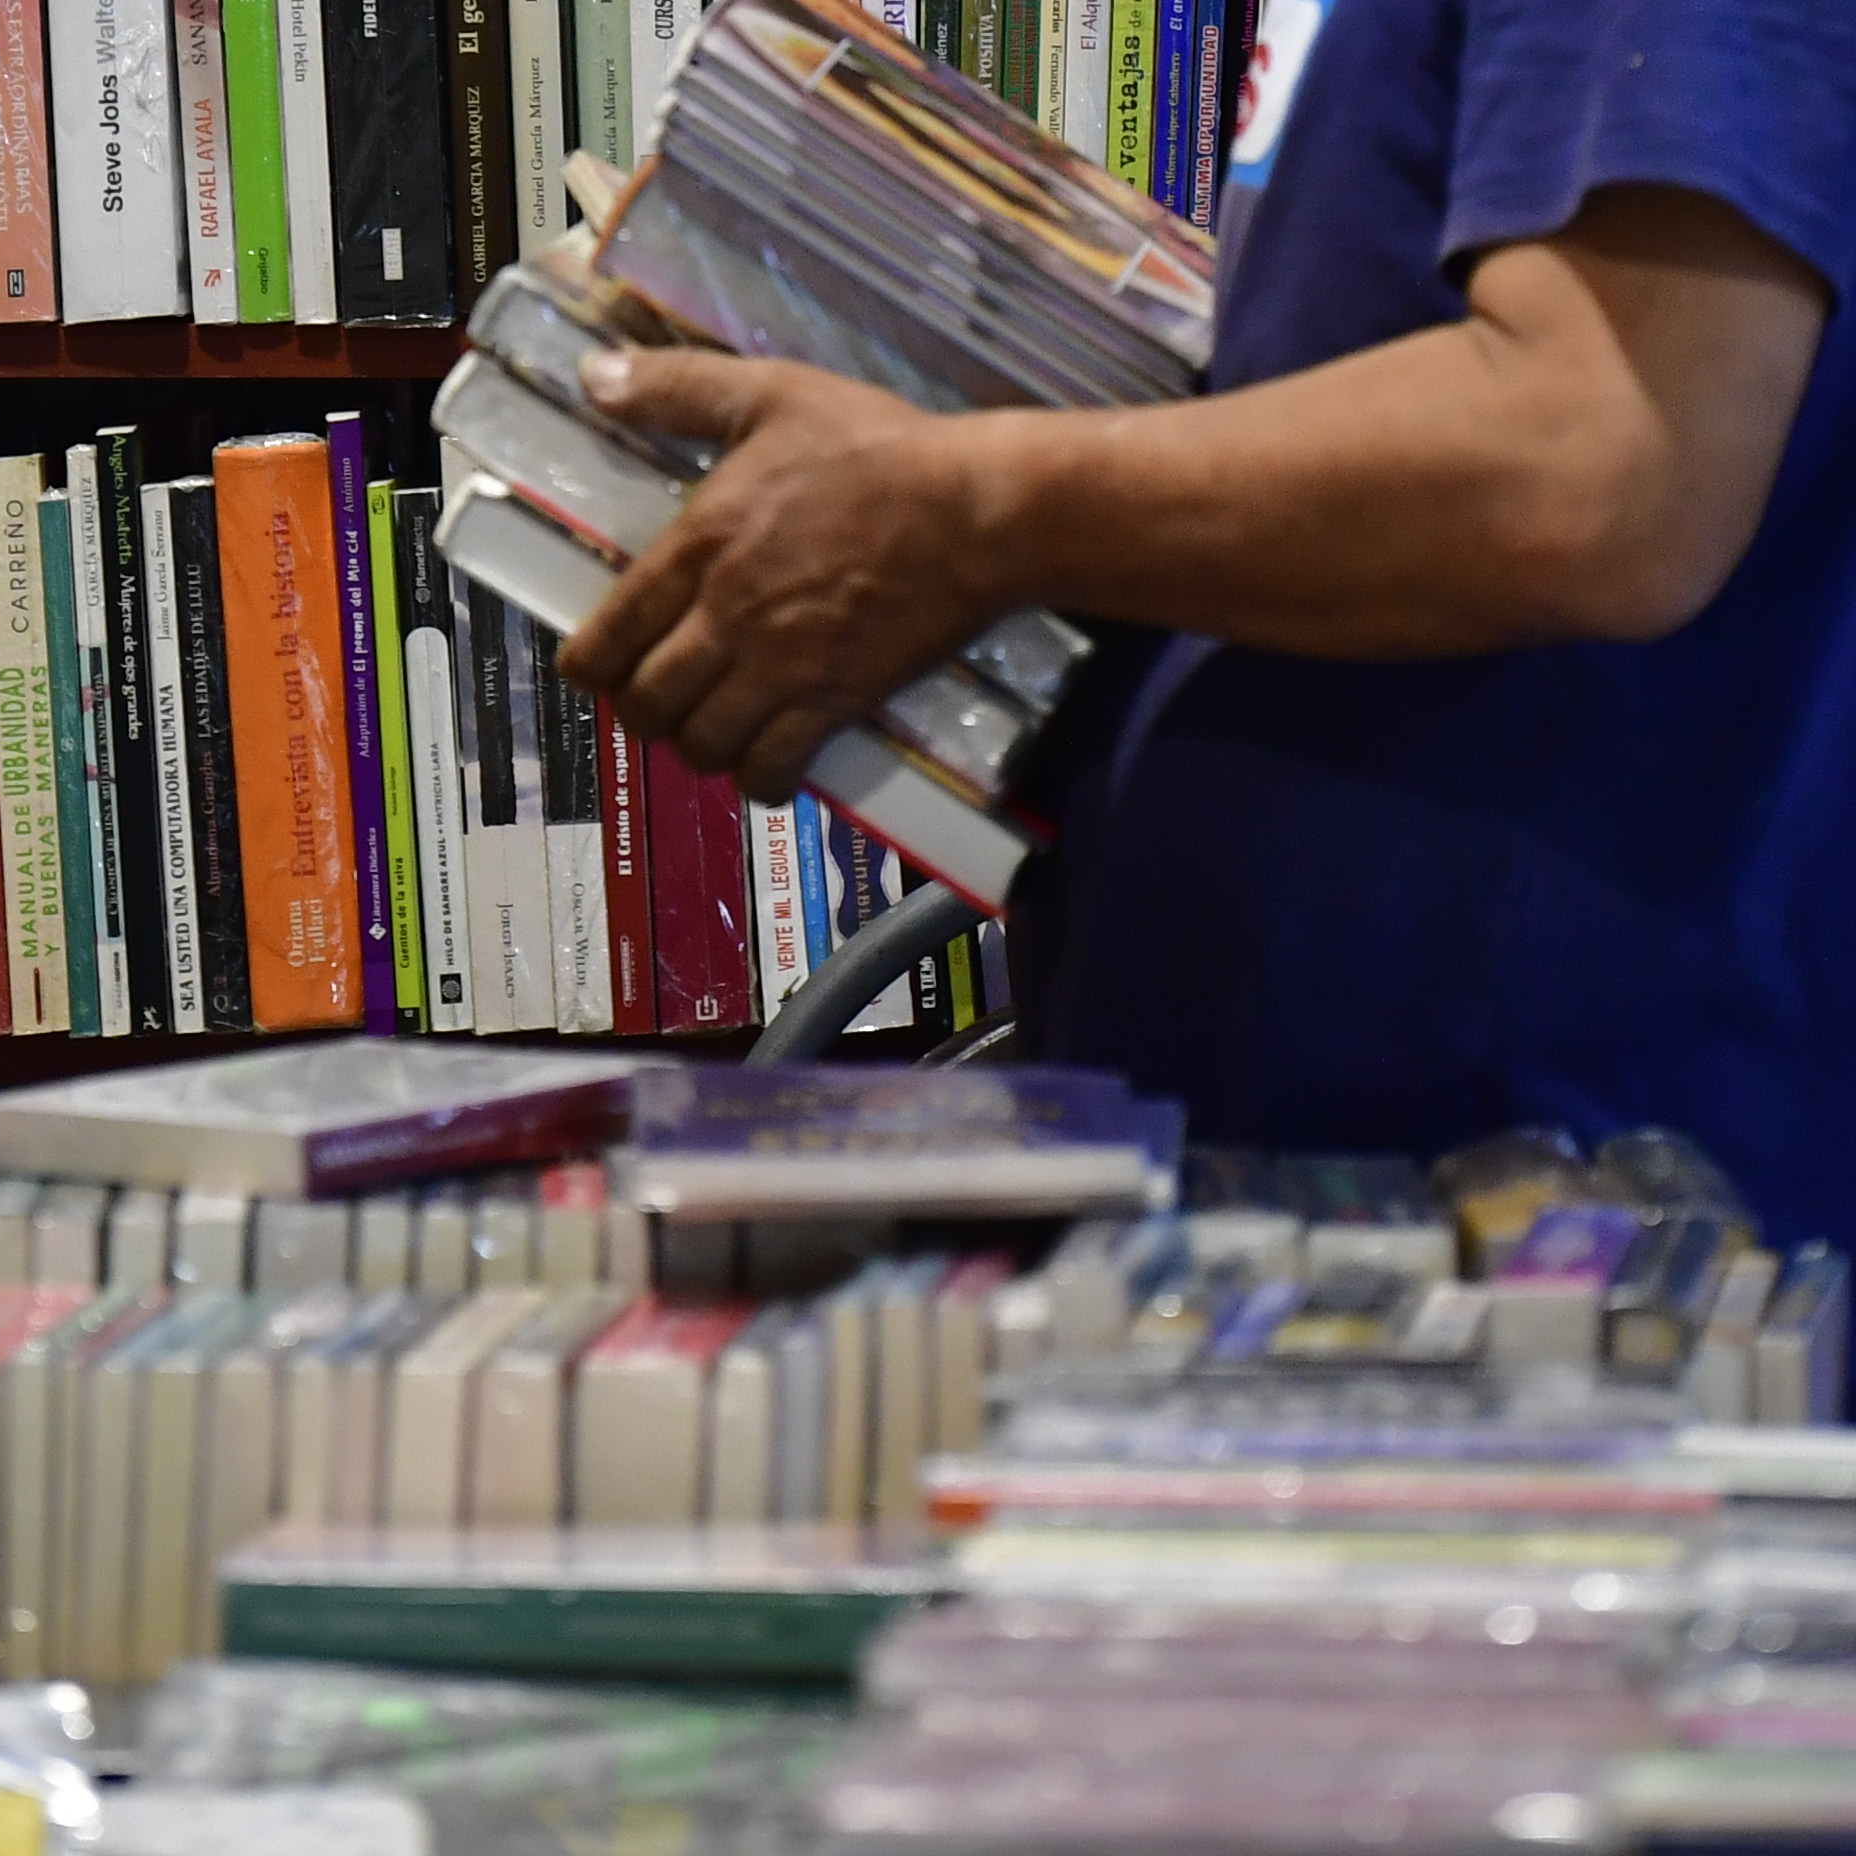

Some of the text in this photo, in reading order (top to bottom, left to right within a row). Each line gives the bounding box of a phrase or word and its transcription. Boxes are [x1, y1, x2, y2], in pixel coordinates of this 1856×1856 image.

[458, 31, 480, 54] El
[1082, 35, 1098, 50] El
[1129, 9, 1141, 28] de
[99, 74, 121, 135] Jobs
[1117, 36, 1145, 167] ventajas
[101, 143, 124, 213] Steve
[5, 499, 29, 633] CARREÑO
[158, 684, 196, 1012] SEA USTED UNA COMPUTADORA HUMANA
[615, 787, 633, 875] El Cristo de
[768, 815, 796, 972] VEINTE MIL LEGUAS DE
